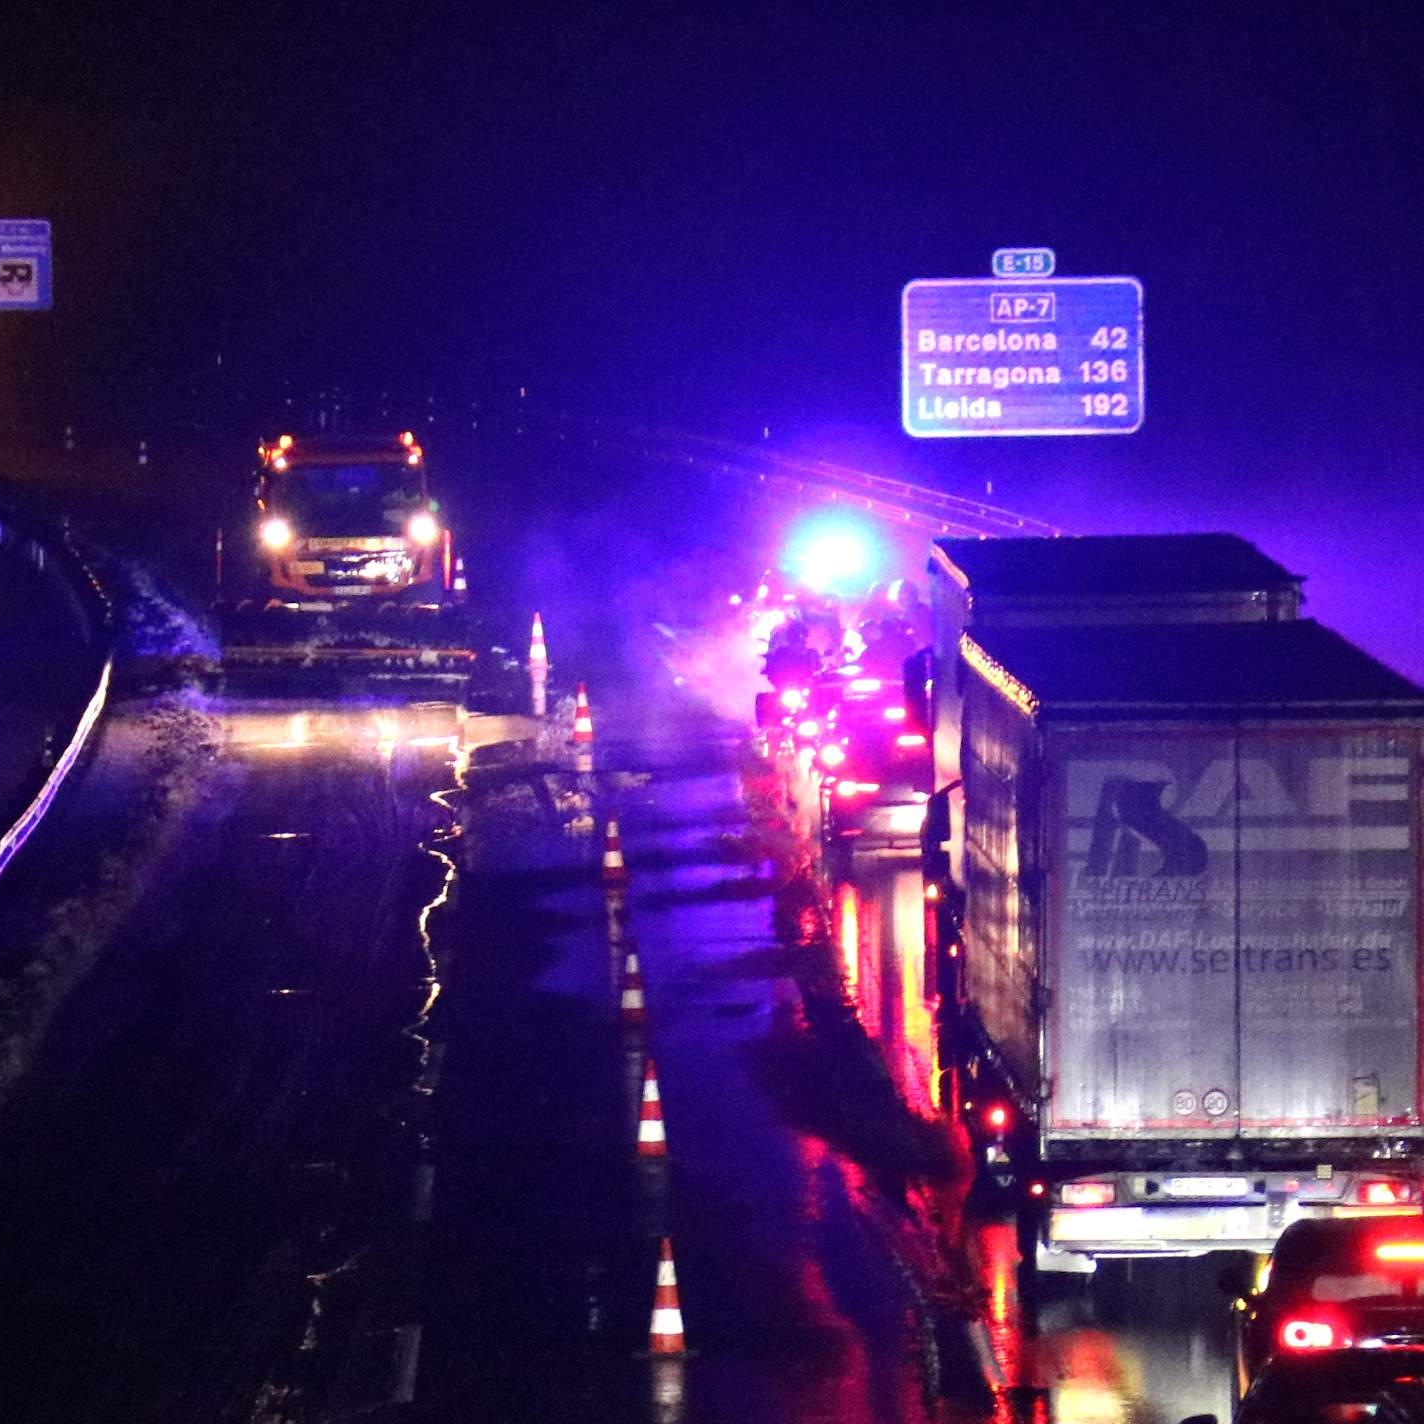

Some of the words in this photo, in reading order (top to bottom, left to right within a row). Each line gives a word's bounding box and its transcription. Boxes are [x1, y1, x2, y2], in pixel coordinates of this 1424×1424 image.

[1003, 254, 1045, 273] E-15
[996, 297, 1050, 317] AP-7
[917, 329, 1058, 352] Barcelona
[1090, 326, 1128, 350] 42
[920, 362, 1061, 389] Tarragona
[1079, 359, 1128, 383] 136
[917, 396, 1002, 420] Lleida
[1080, 393, 1129, 416] 192
